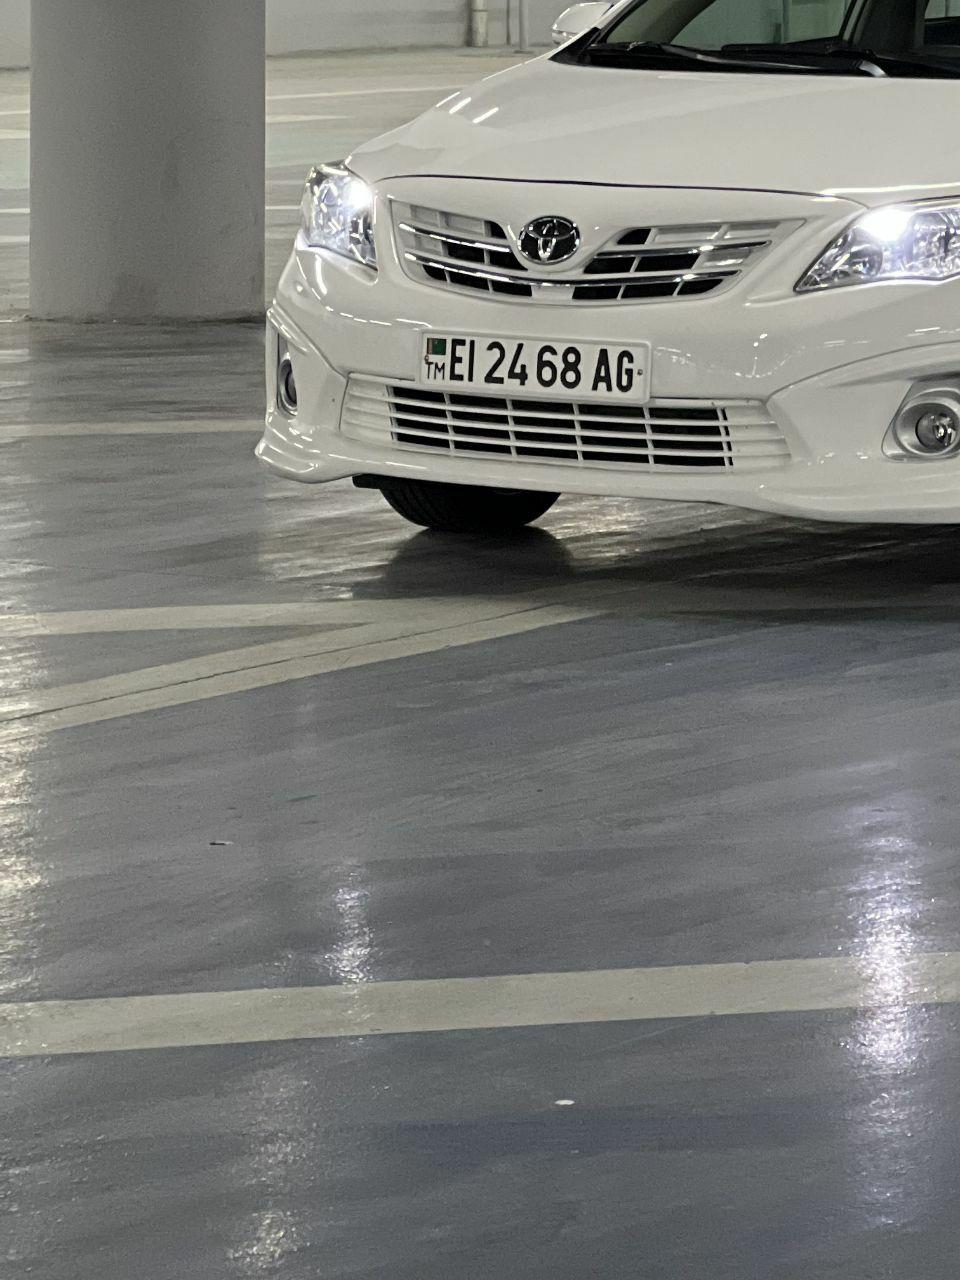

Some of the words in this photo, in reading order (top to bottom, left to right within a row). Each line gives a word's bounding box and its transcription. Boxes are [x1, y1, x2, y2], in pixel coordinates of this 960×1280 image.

[427, 361, 446, 380] TM
[450, 339, 475, 382] EI
[591, 348, 634, 393] AG
